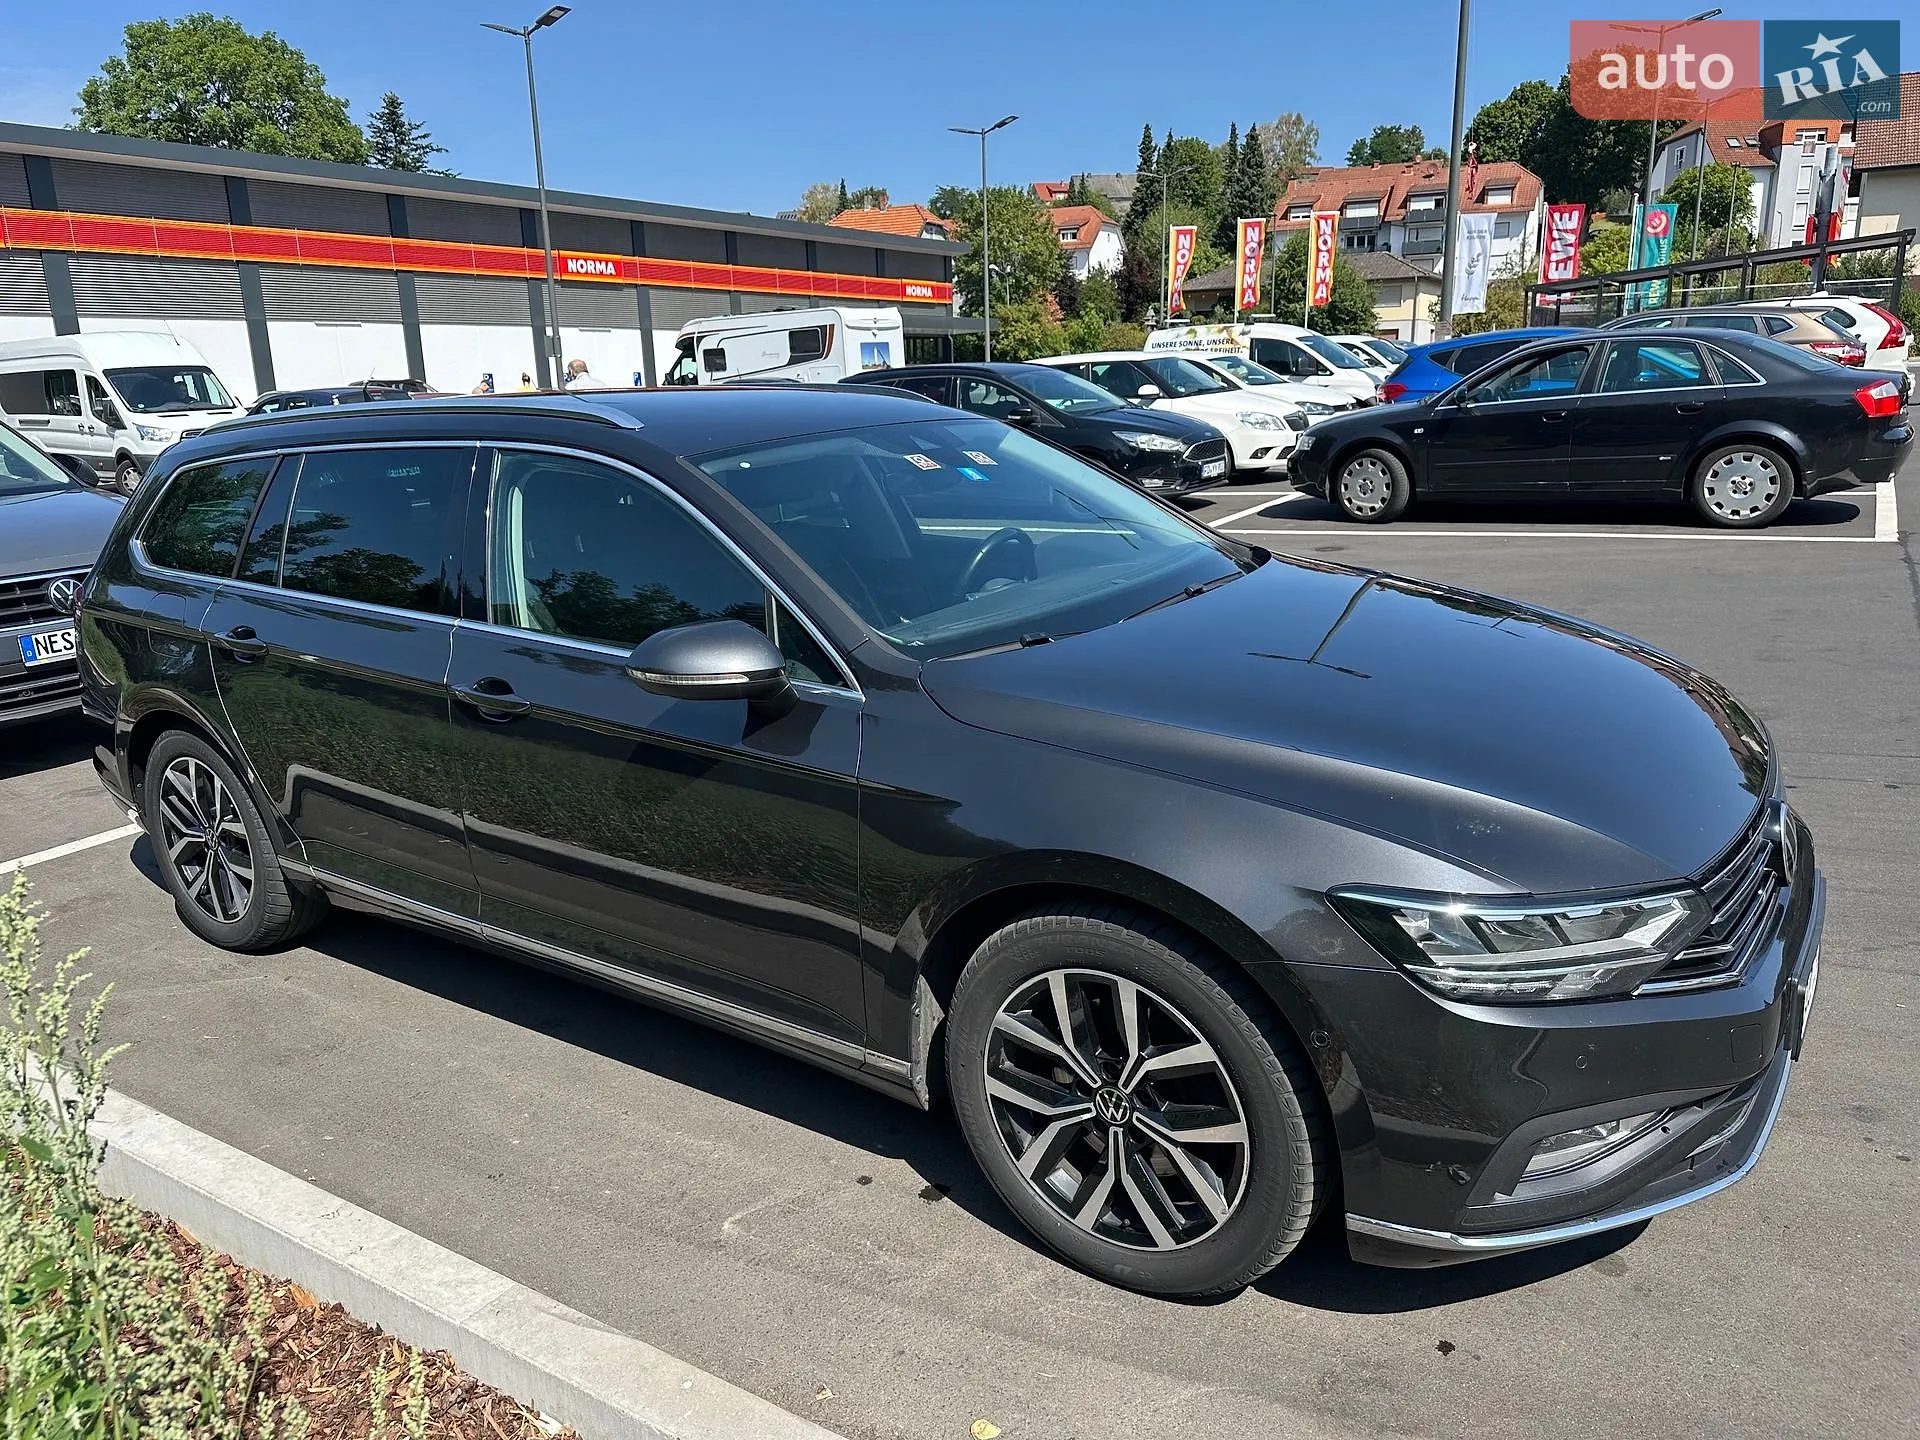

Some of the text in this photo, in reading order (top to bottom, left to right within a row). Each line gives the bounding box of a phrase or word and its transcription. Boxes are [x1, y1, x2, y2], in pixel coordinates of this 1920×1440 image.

[567, 258, 616, 275] NORMA
[1172, 234, 1191, 307] NORMA
[1243, 226, 1260, 304] NORMA
[1315, 218, 1333, 299] NORMA
[906, 285, 933, 298] NORMA
[1151, 337, 1234, 349] UNSERE SONNE, UNSERE
[34, 631, 75, 657] NES
